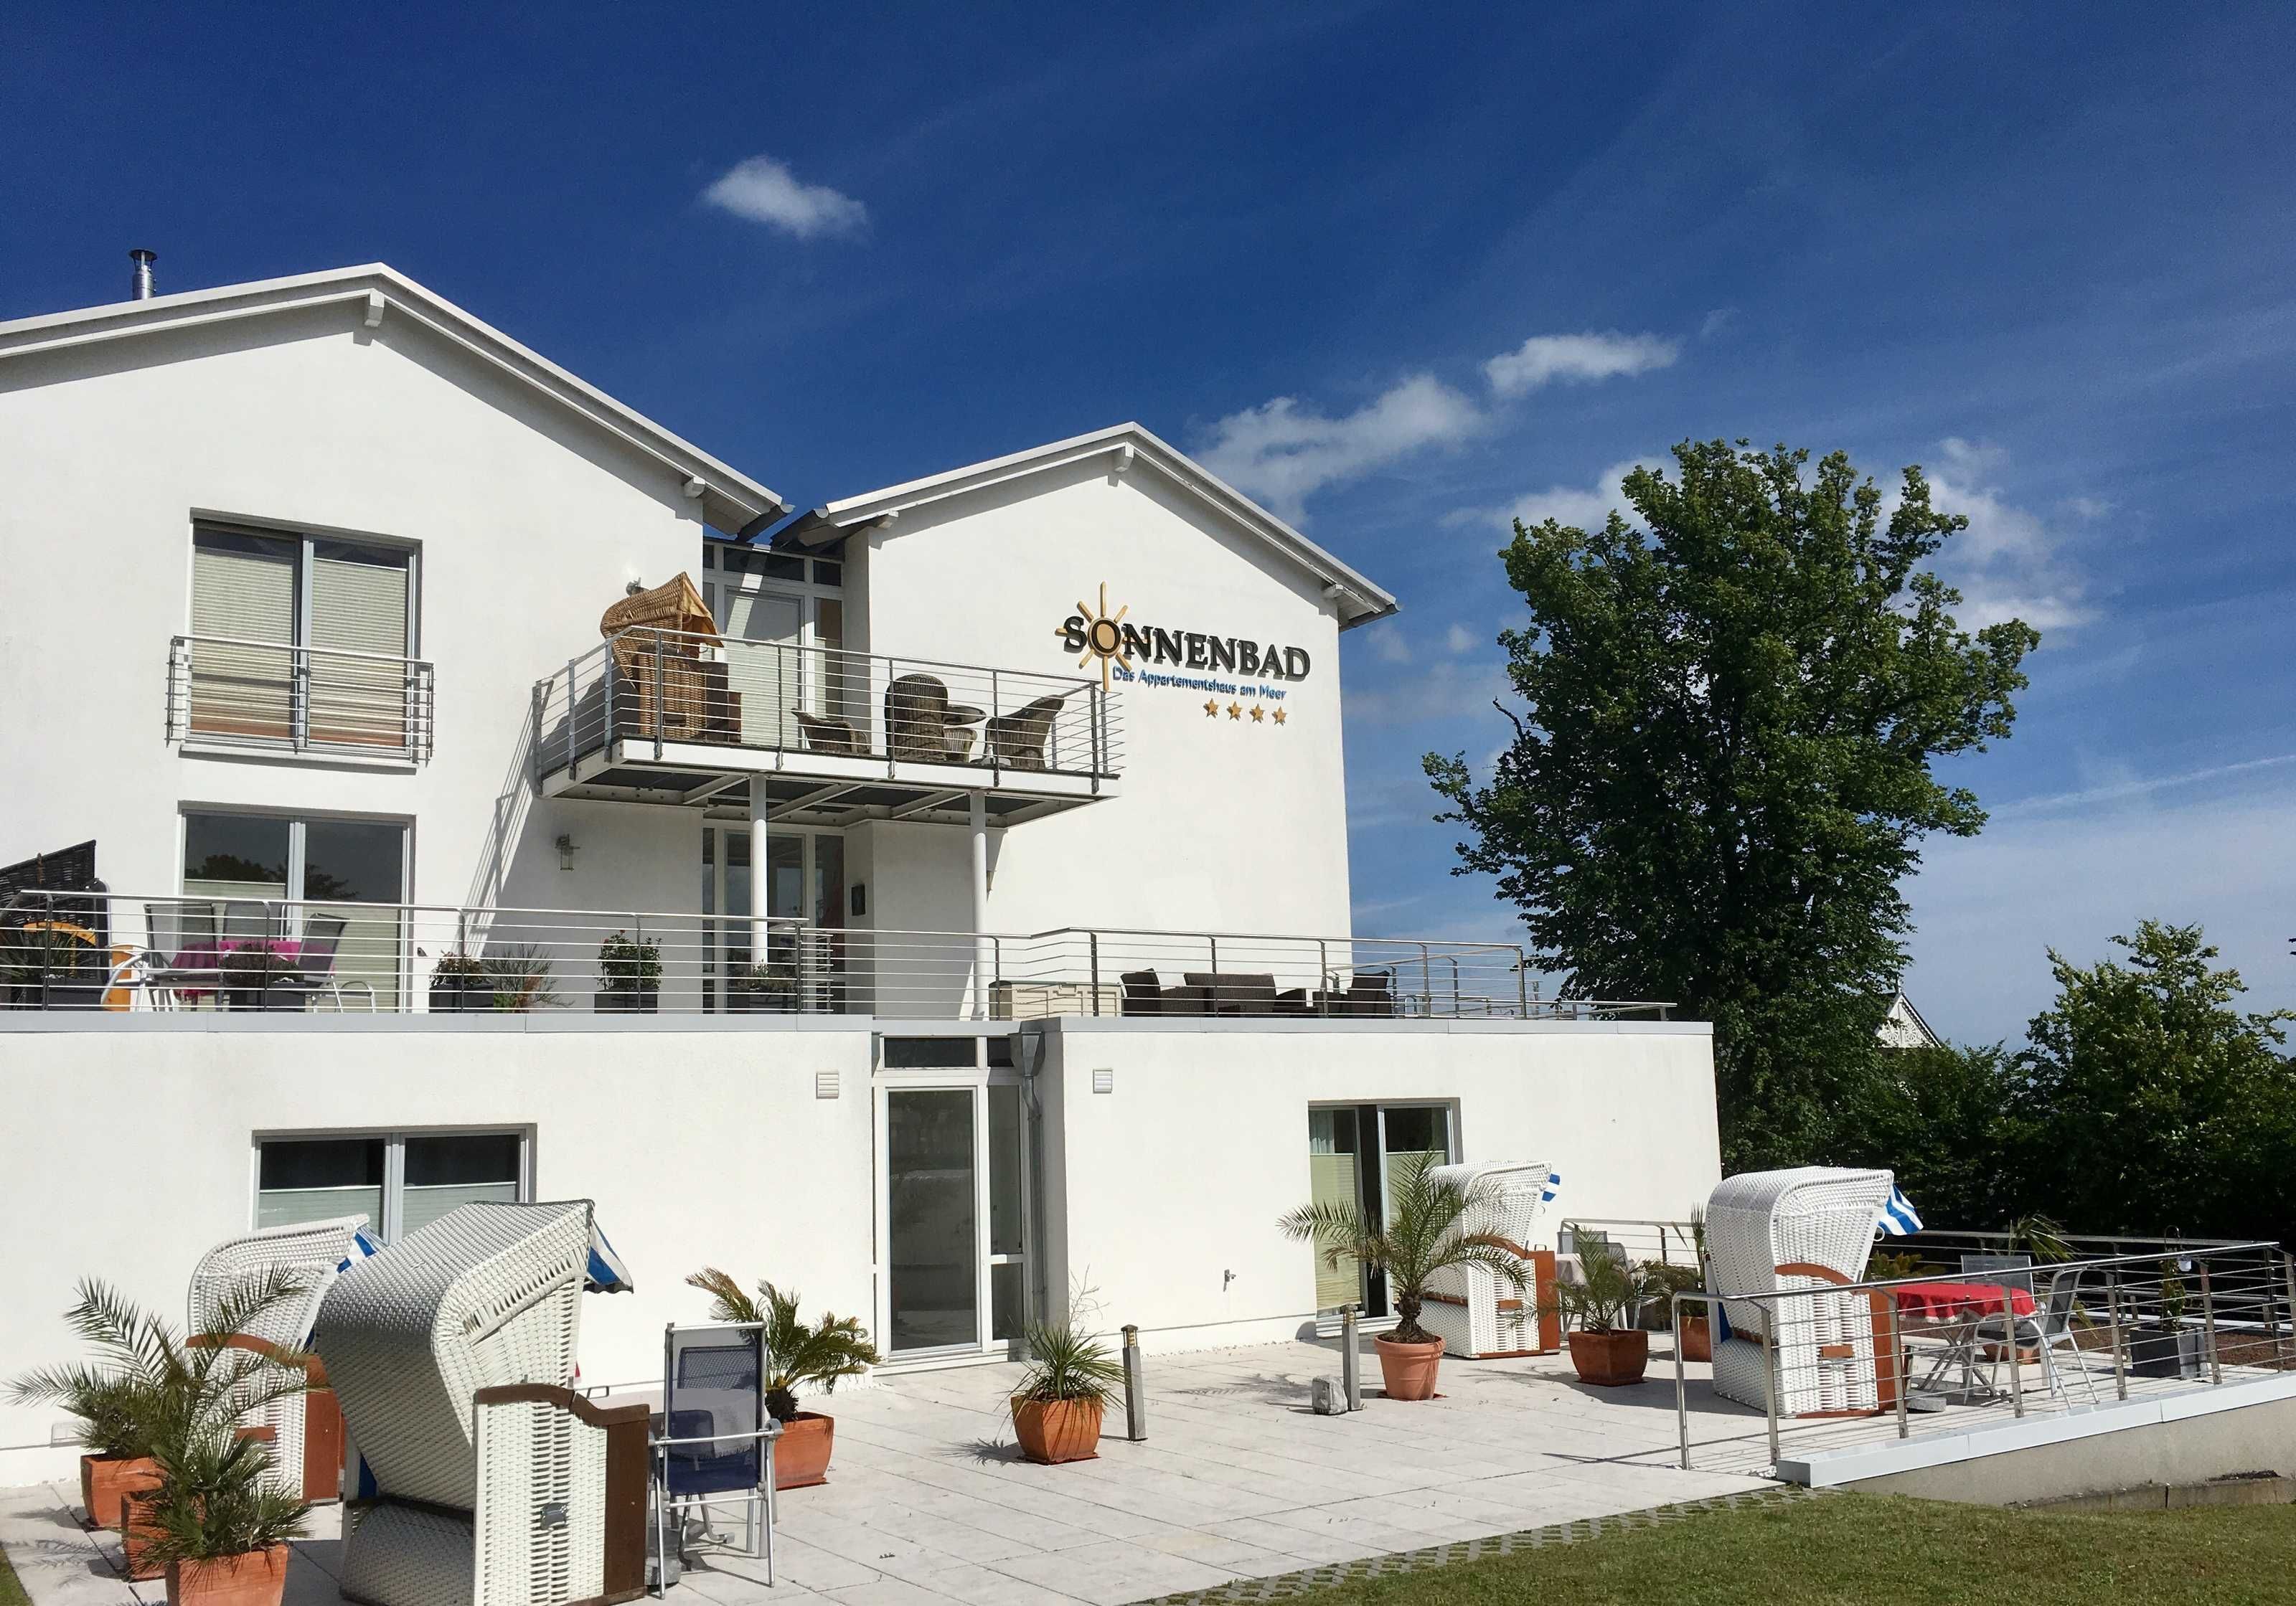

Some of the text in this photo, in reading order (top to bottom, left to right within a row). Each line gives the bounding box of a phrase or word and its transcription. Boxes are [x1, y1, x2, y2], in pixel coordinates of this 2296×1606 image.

[1063, 615, 1310, 679] SONNENBAD
[1112, 666, 1287, 700] Das Appartementshaus am Meer
